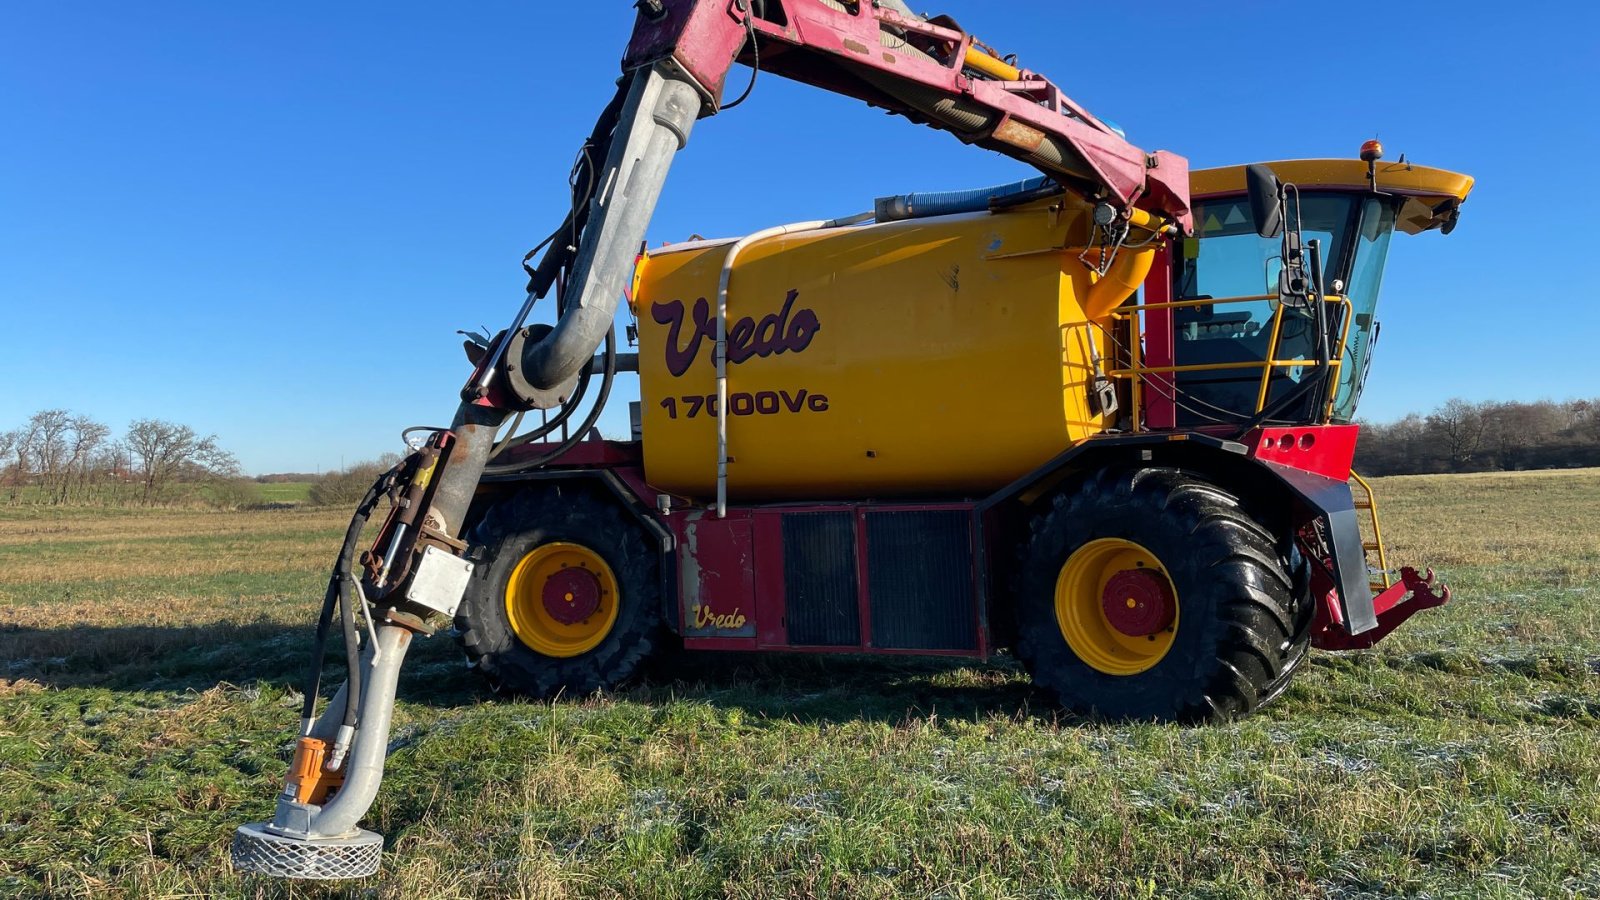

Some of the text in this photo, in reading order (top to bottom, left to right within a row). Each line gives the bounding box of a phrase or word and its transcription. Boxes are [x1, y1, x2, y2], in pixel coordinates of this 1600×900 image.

[651, 289, 820, 377] Vredo
[660, 389, 829, 419] 17000Vc
[692, 604, 746, 629] Vredo
